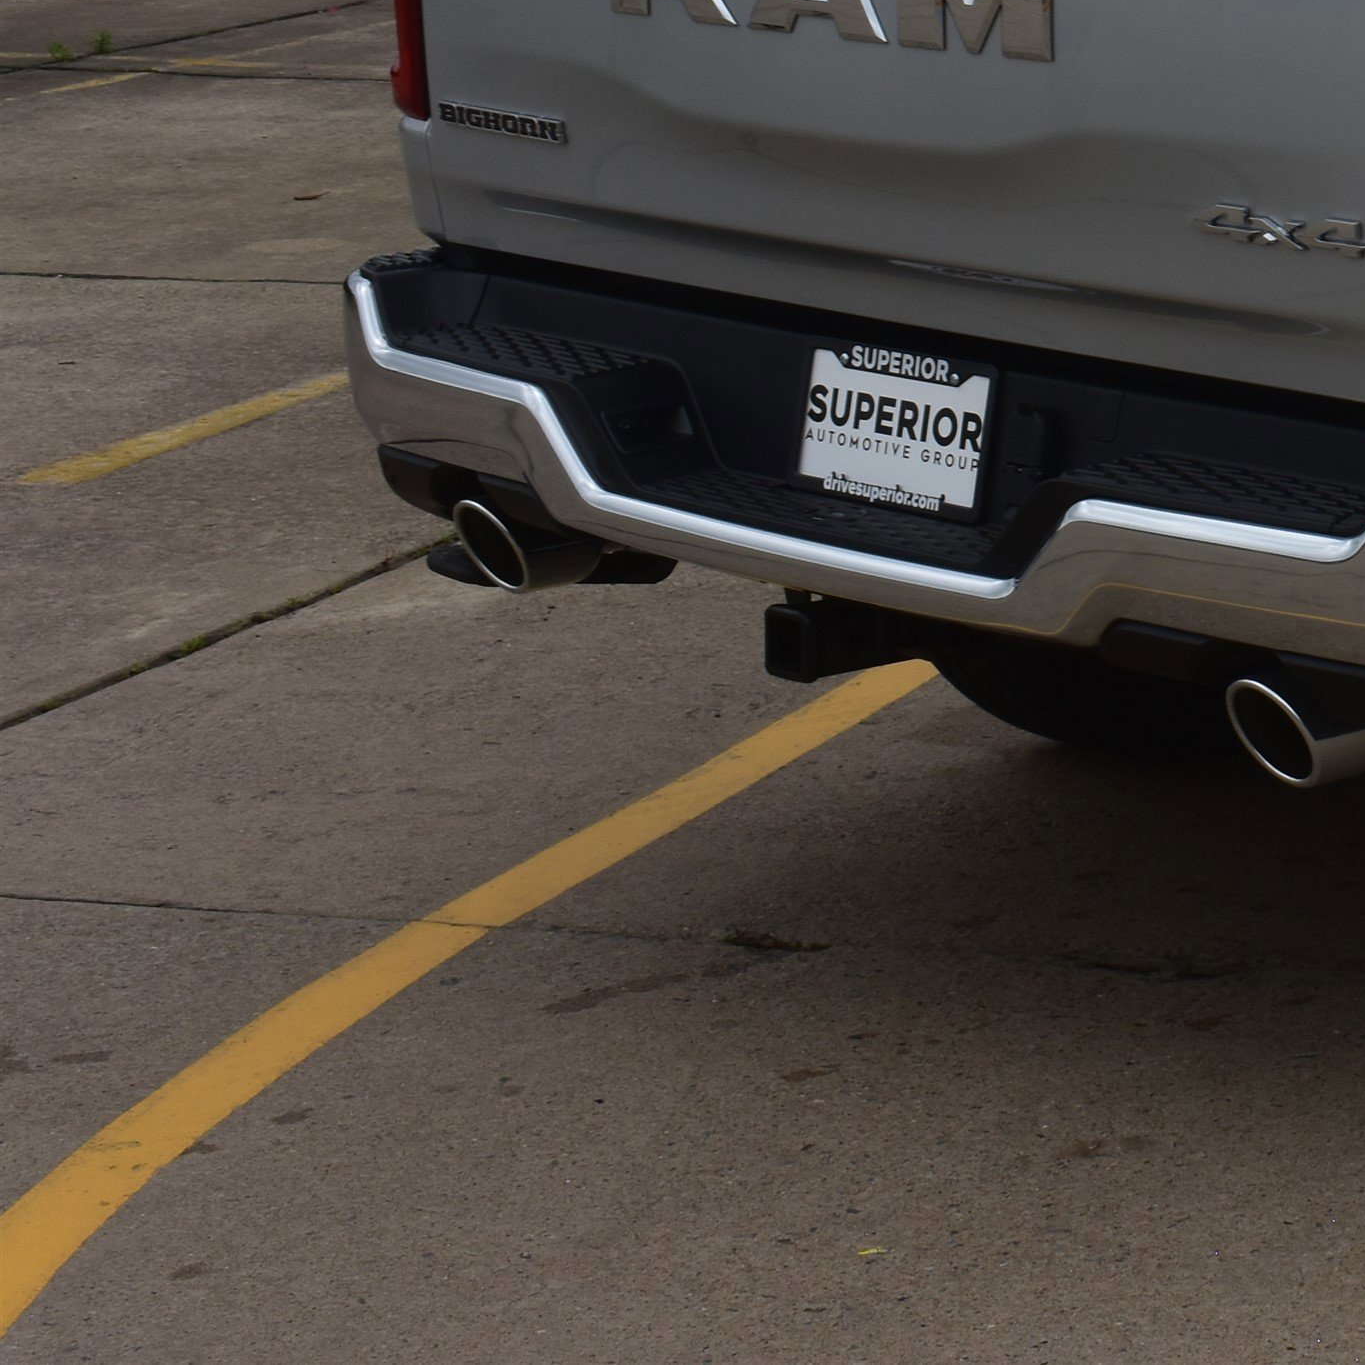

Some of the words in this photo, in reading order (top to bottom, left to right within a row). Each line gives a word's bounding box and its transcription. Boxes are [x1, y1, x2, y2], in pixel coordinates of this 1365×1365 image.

[438, 101, 564, 143] BIGHORN
[851, 345, 949, 382] SUPERIOR
[808, 384, 982, 452] SUPERIOR
[805, 427, 910, 459] AUTOMOTIVE
[921, 449, 980, 471] GROUP
[823, 475, 940, 511] drivesuperior.com
